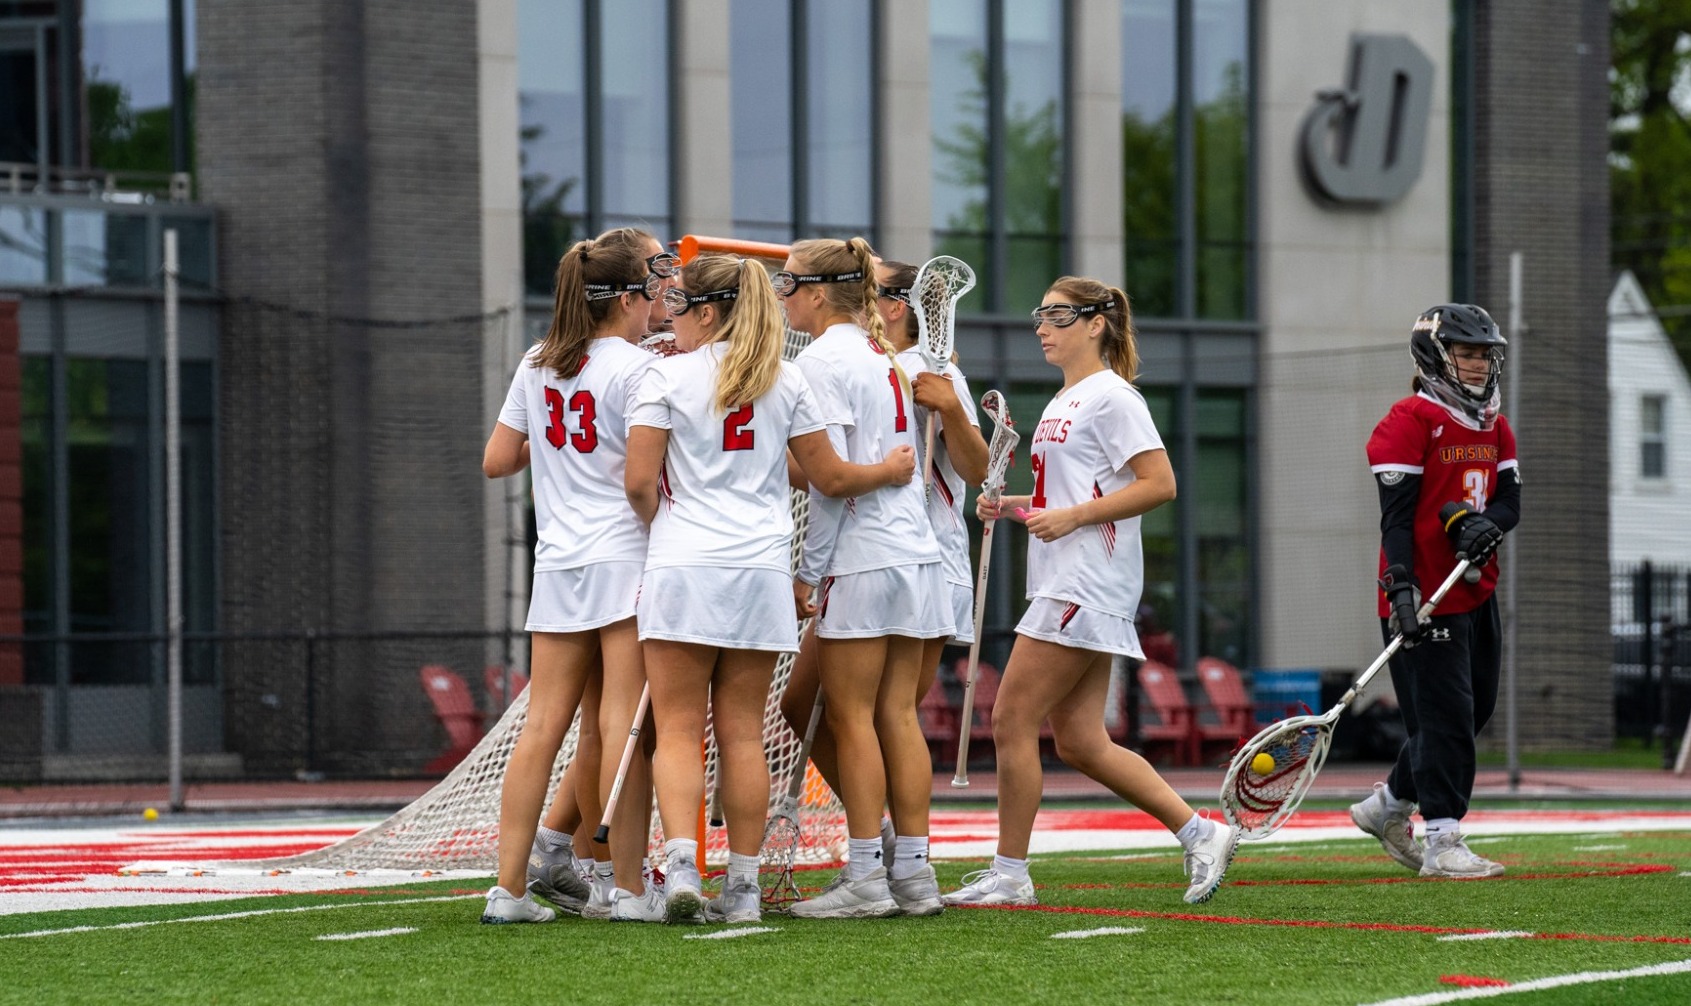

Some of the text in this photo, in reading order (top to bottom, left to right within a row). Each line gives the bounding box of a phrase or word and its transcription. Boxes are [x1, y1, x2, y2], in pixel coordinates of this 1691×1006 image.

[543, 384, 599, 453] 33
[723, 399, 755, 452] 2
[887, 366, 907, 433] 1
